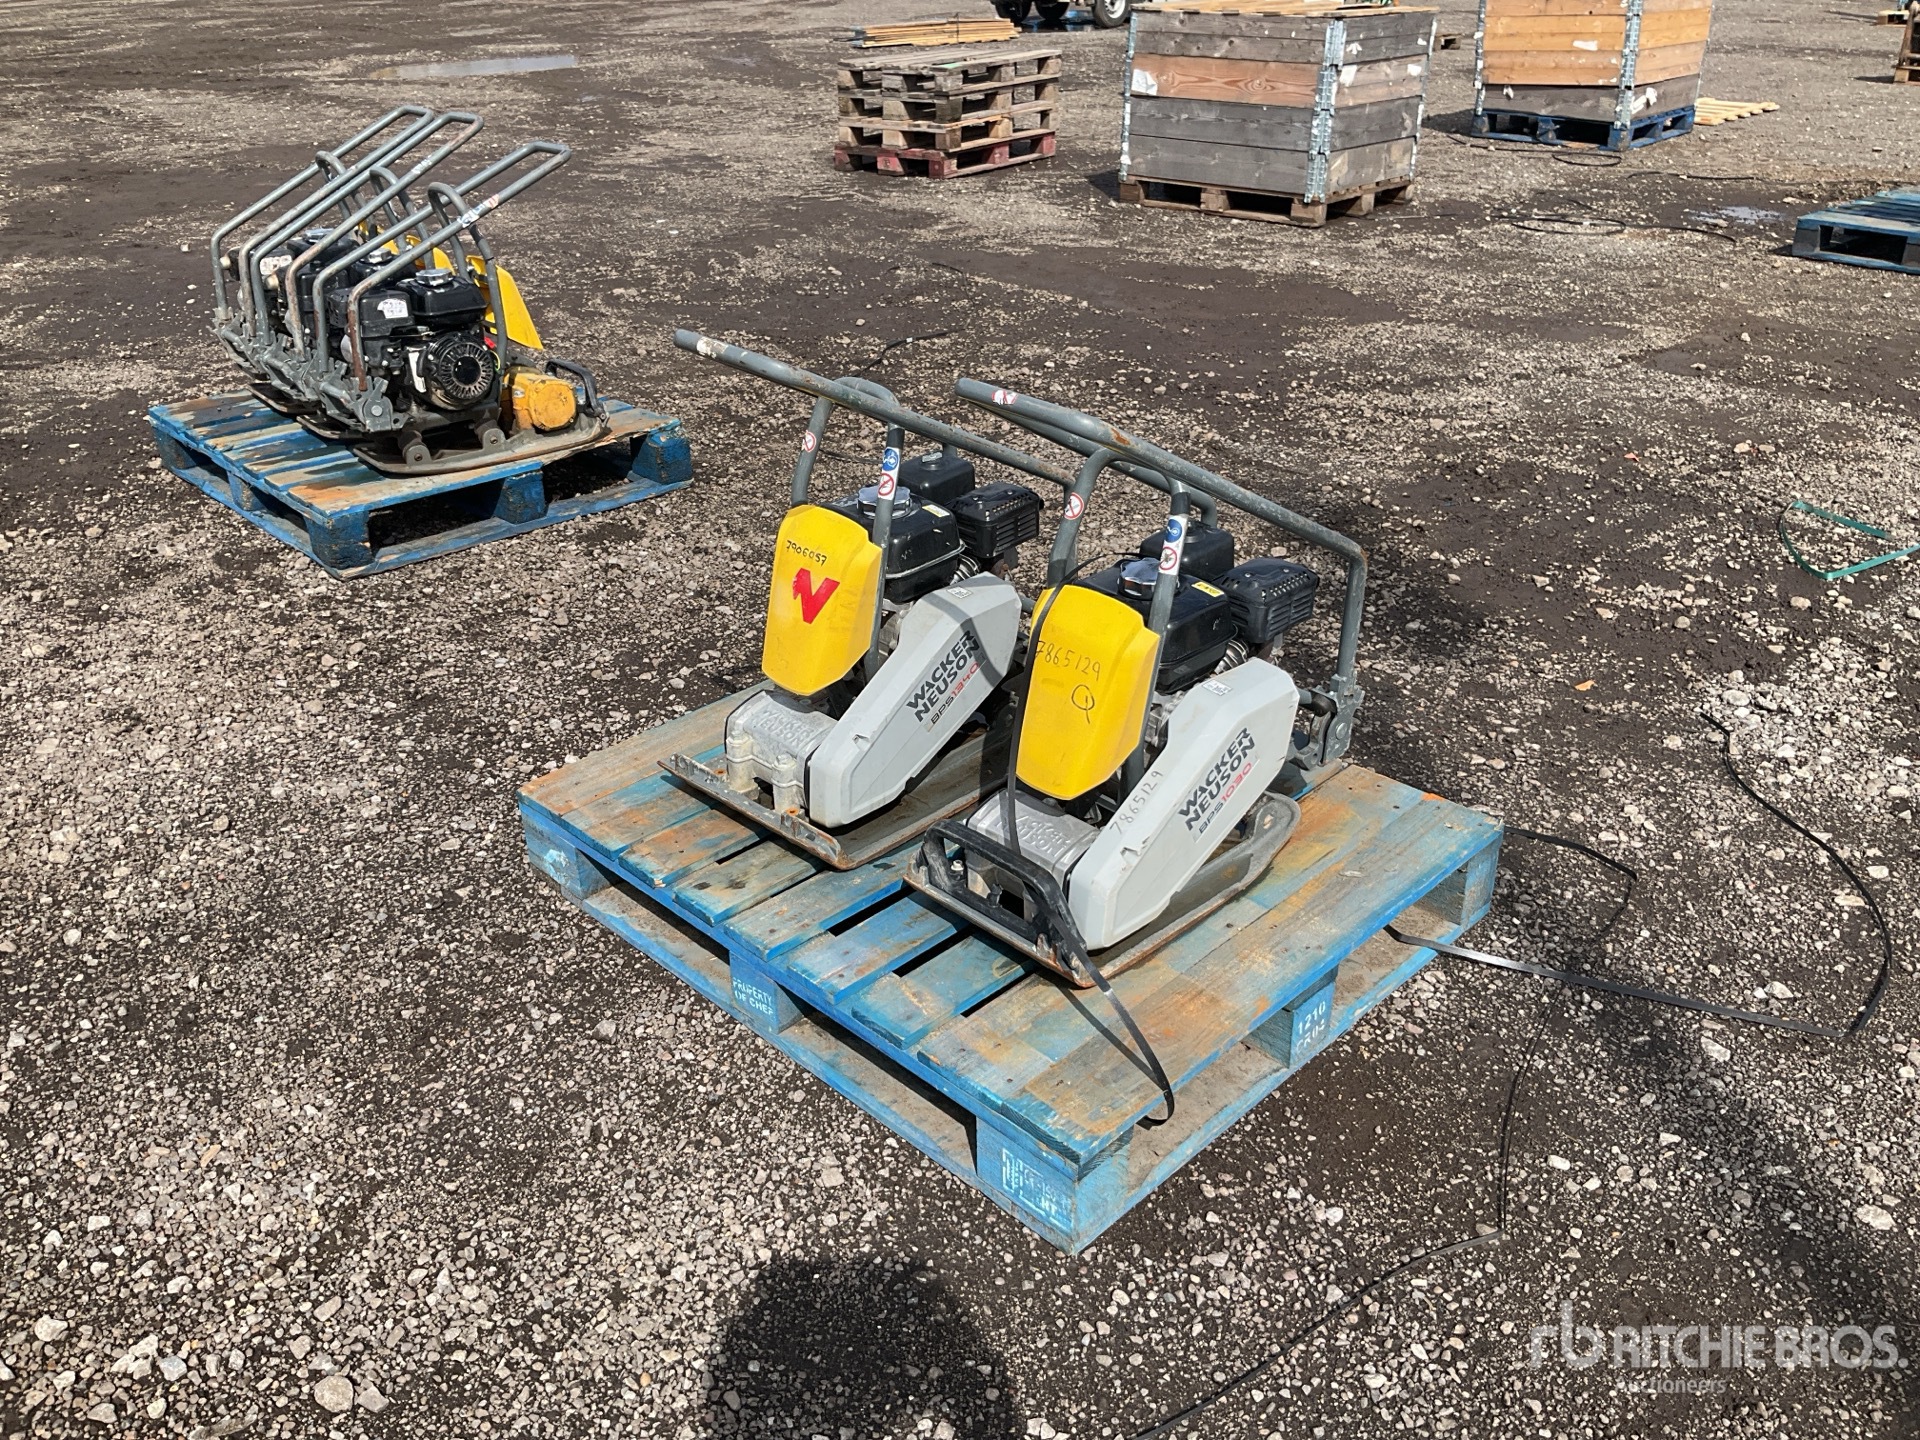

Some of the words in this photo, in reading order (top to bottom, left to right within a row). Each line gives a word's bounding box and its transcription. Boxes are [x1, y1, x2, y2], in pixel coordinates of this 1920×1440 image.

[906, 629, 976, 709] WACKER
[914, 637, 980, 723] NEUSON
[1035, 640, 1101, 682] 7865129
[1108, 770, 1164, 834] 7865129
[1178, 727, 1251, 817] WACKER
[1185, 736, 1255, 831] NEUSON
[1298, 1000, 1326, 1035] 1210
